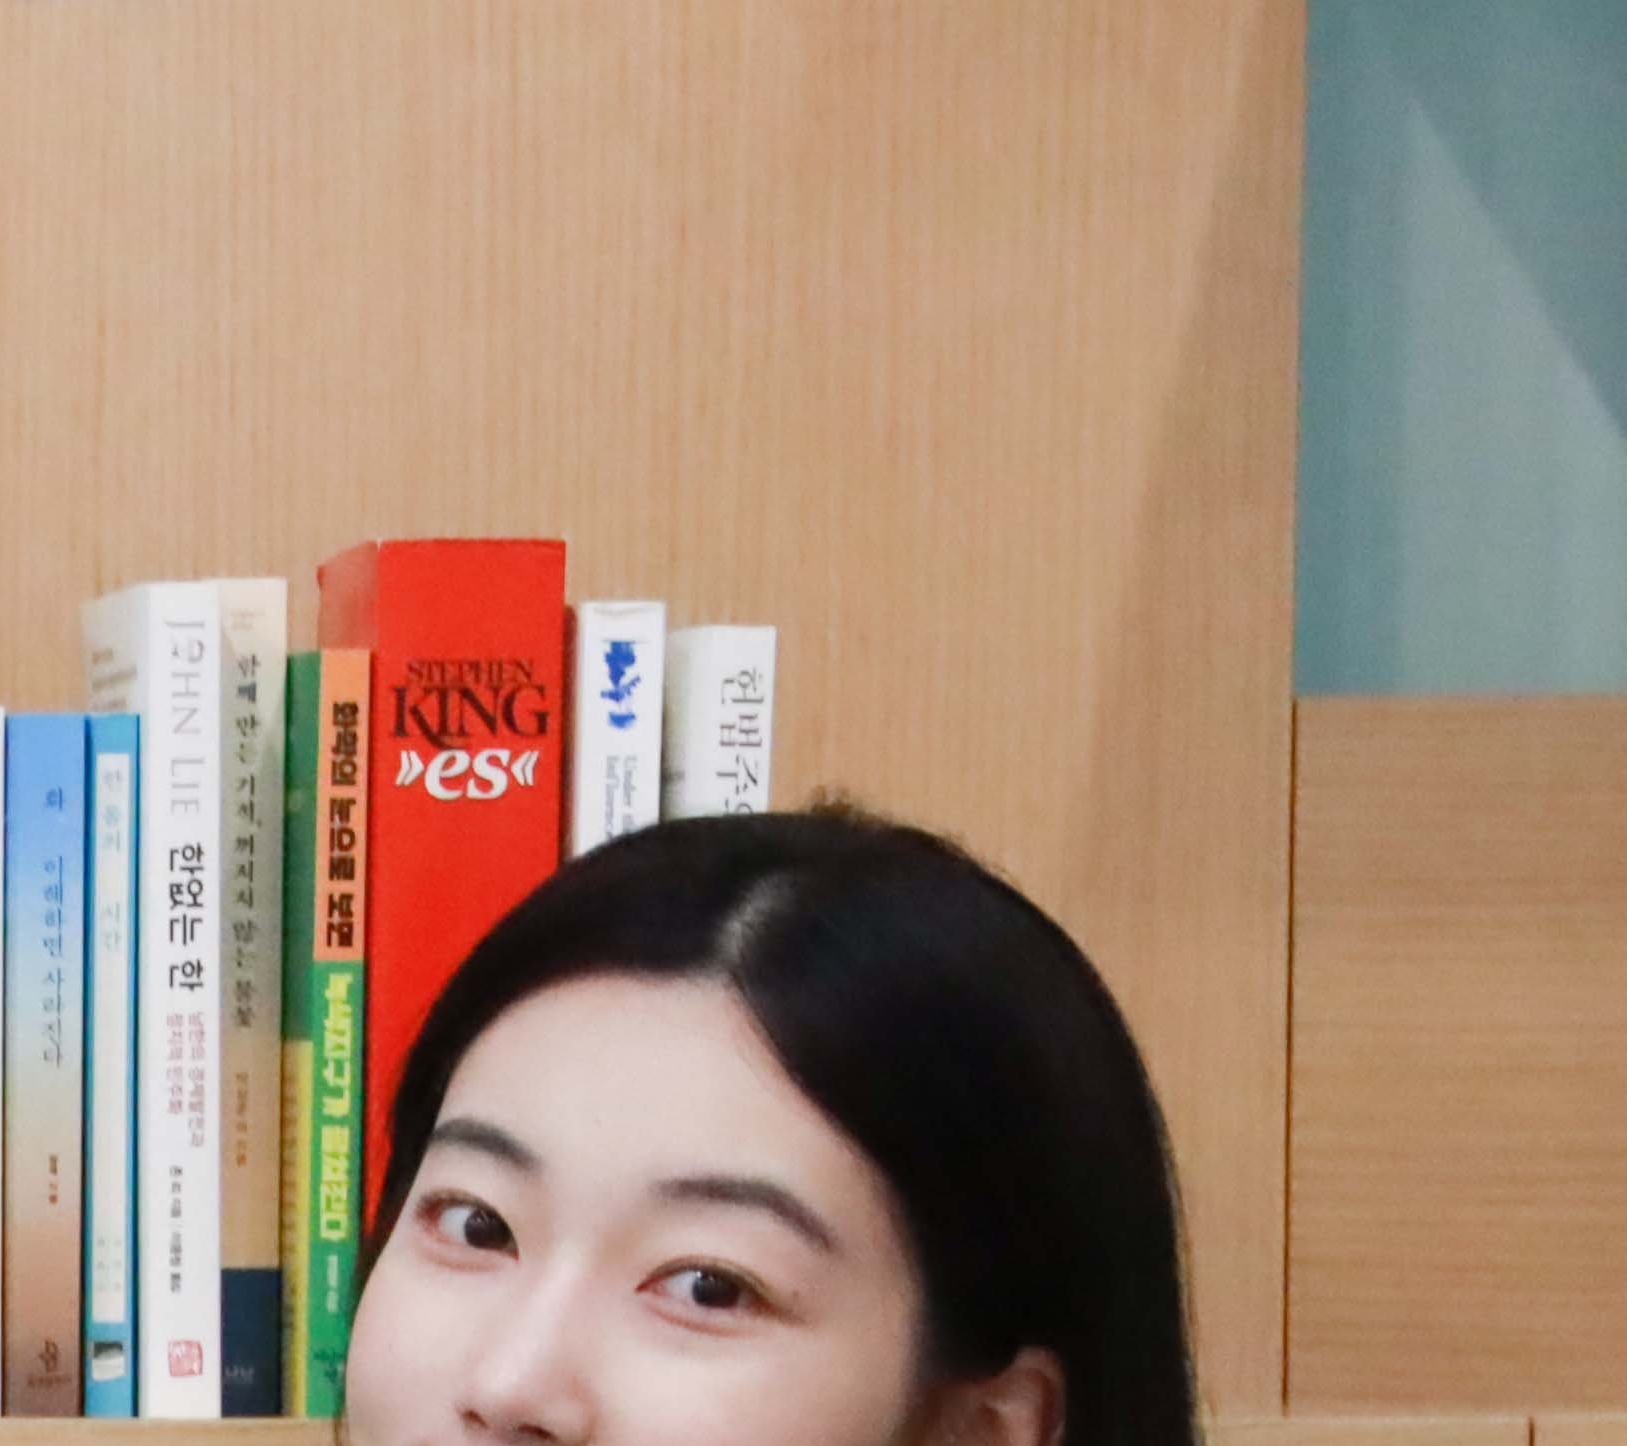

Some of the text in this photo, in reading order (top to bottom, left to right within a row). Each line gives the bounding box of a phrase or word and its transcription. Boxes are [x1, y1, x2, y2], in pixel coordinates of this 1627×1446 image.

[407, 659, 535, 686] STEPHEN
[389, 683, 551, 751] KING
[170, 757, 206, 816] LIE
[168, 842, 205, 991] 한없는 한
